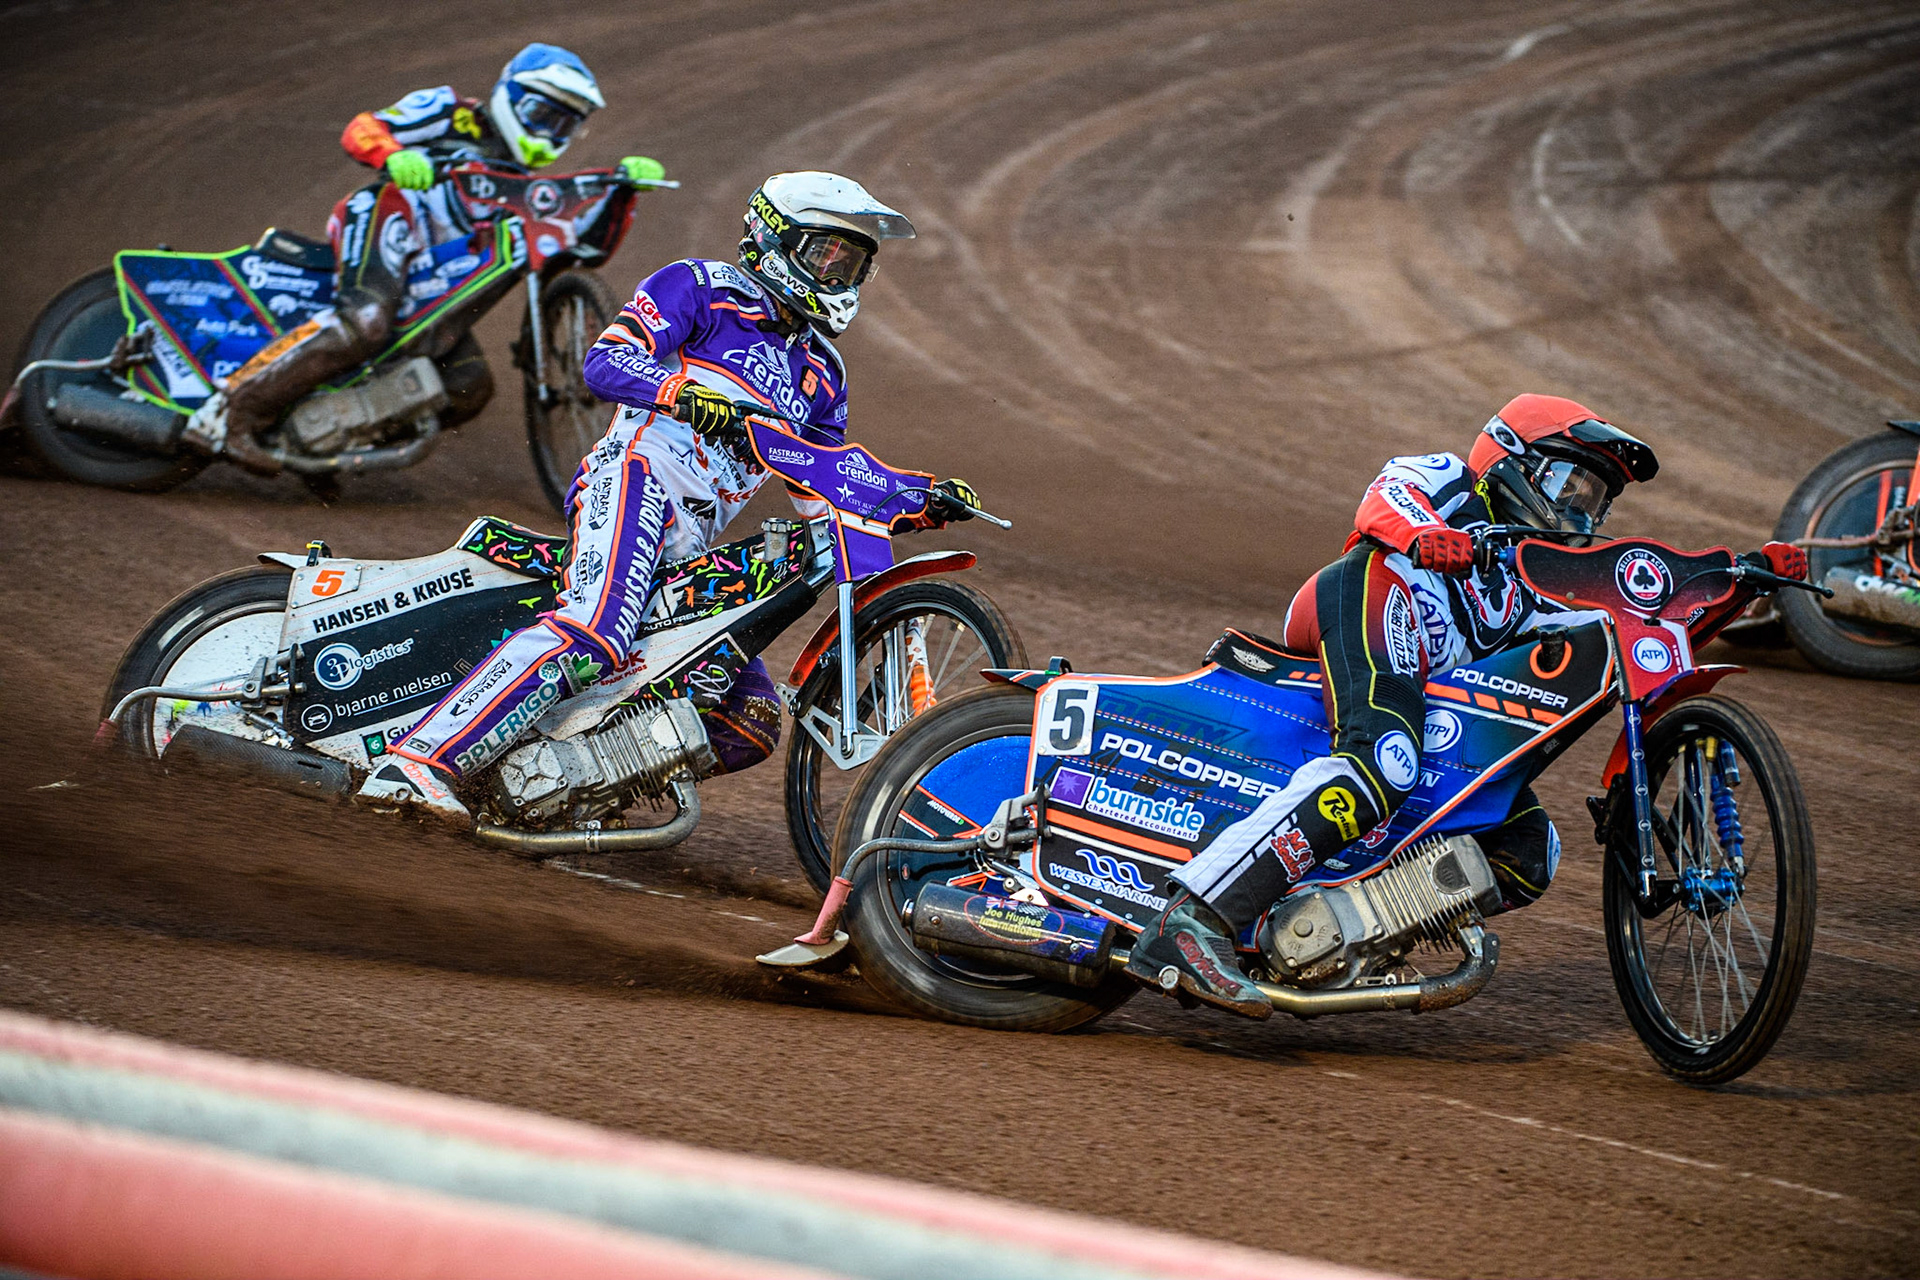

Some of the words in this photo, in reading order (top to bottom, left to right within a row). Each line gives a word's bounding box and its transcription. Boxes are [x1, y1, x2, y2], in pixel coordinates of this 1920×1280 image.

[751, 193, 790, 234] OAKLEY
[711, 270, 758, 296] Creo
[607, 347, 670, 382] Cendon
[742, 369, 770, 395] TIMBER
[802, 369, 819, 396] 5
[768, 447, 805, 459] FASTRACK
[836, 461, 887, 488] Crendon
[598, 477, 612, 518] FATRACK
[637, 475, 670, 544] KRUSE
[858, 507, 878, 518] GROP
[863, 503, 887, 514] AUCTON
[636, 536, 656, 561] &
[311, 569, 346, 597] 5
[313, 598, 390, 633] HANSEN
[394, 592, 410, 609] &
[412, 568, 475, 603] KRUSE
[614, 551, 652, 648] HANSEN
[349, 642, 411, 669] logistics
[610, 650, 646, 675] GK
[1640, 649, 1665, 660] ATPI
[465, 660, 513, 706] FASTRACK
[600, 674, 623, 687] SPARK
[624, 664, 648, 678] PLUGS
[1450, 668, 1569, 709] POLCOPPER
[335, 690, 389, 718] bjarne
[393, 671, 452, 698] nielsen
[456, 682, 559, 772] 3PLFRIGO
[1048, 689, 1090, 751] 5
[1424, 722, 1450, 738] ATPI
[1099, 732, 1281, 799] POLCOPPER
[1385, 744, 1414, 777] ATPI
[1091, 777, 1203, 831] burnside
[1087, 802, 1136, 823] chartered
[1138, 818, 1198, 840] accountants
[984, 907, 1003, 918] Joe
[1005, 911, 1042, 927] Hughes
